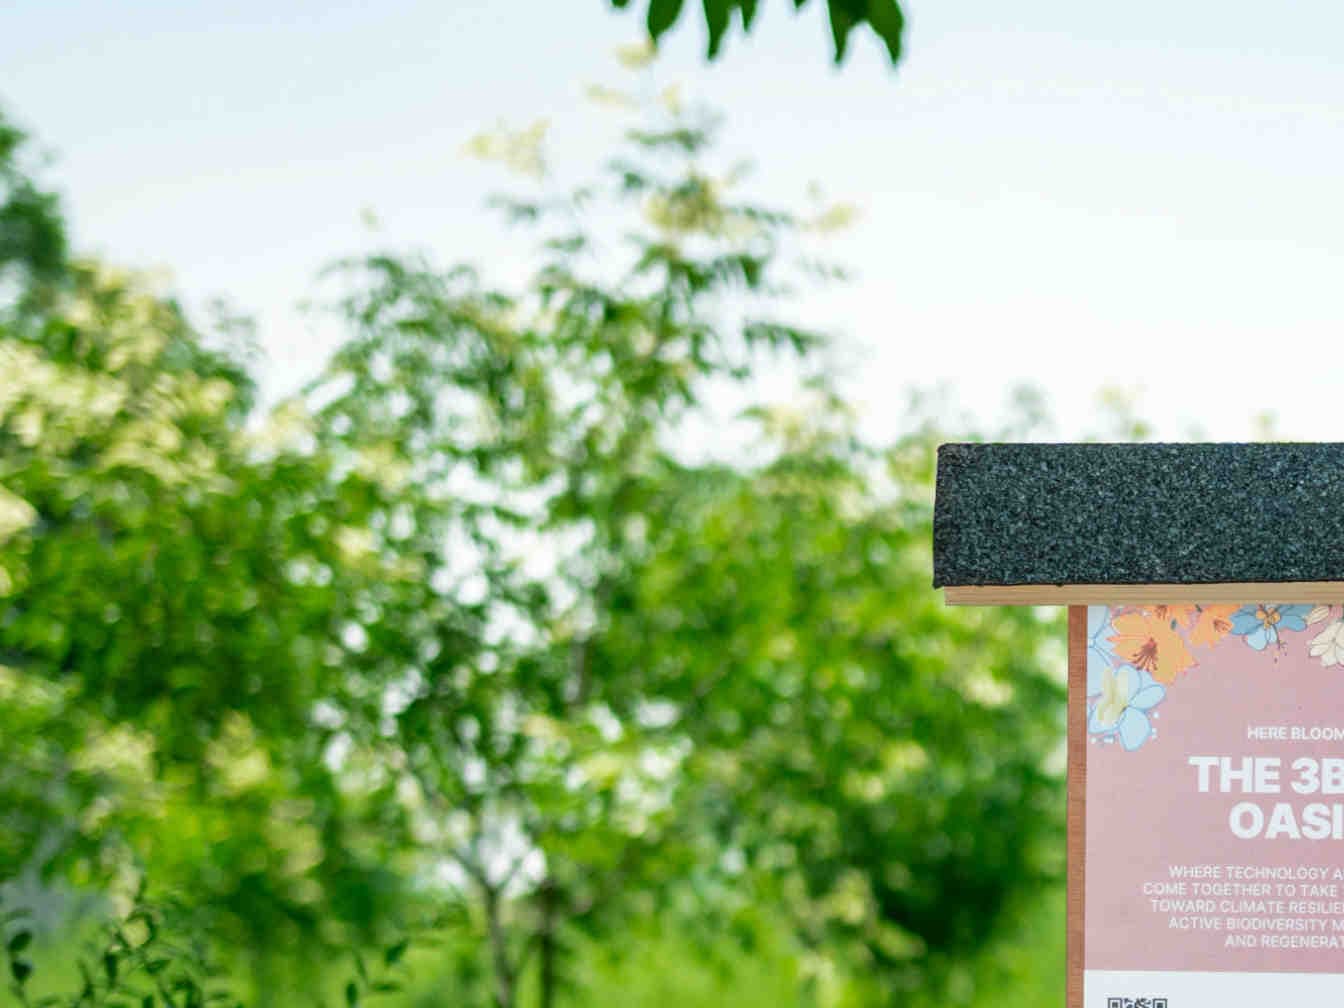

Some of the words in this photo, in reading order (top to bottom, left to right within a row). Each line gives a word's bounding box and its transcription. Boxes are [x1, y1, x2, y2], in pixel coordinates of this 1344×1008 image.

[1247, 725, 1287, 740] HERE
[1188, 756, 1281, 794] THE
[1168, 865, 1222, 879] WHERE
[1225, 865, 1329, 880] TECHNOLOGY
[1143, 882, 1187, 896] COME
[1191, 882, 1272, 897] TOGETHER
[1276, 883, 1296, 897] TO
[1300, 884, 1338, 898] TAKE
[1150, 899, 1217, 913] TOWARD
[1219, 900, 1286, 914] CLIMATE
[1168, 916, 1222, 931] ACTIVE
[1226, 917, 1328, 931] BIODIVERSITY
[1224, 934, 1257, 948] AND
